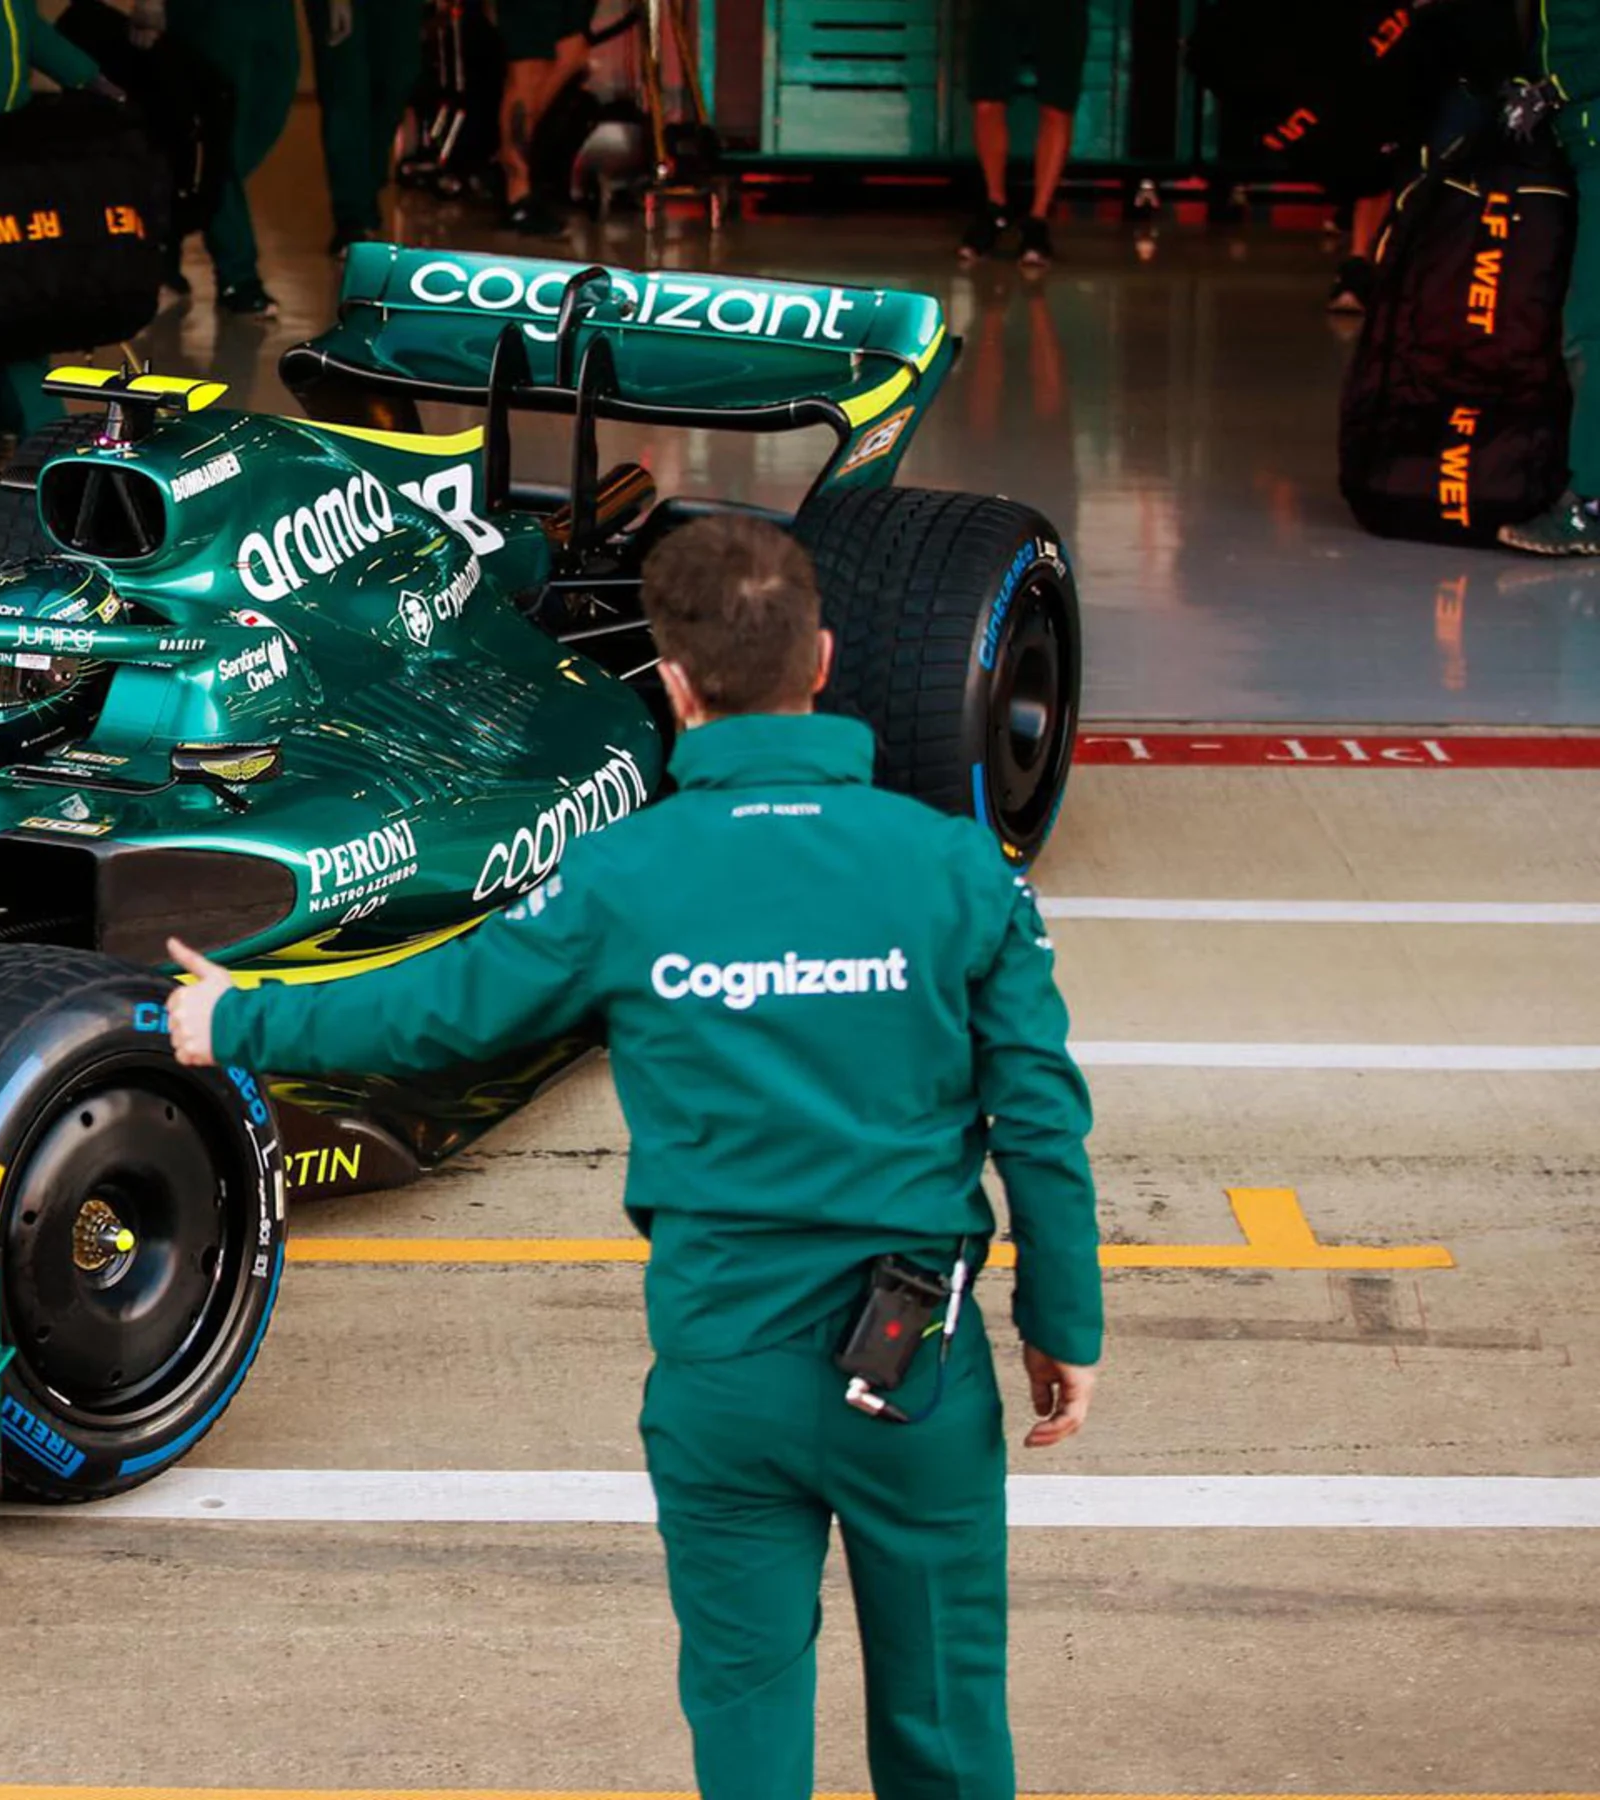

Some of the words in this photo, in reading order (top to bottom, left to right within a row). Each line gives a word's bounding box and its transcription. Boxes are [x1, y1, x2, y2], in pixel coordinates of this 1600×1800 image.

[27, 209, 62, 241] RF
[410, 261, 854, 342] cognizant
[1467, 249, 1502, 334] WET
[169, 450, 242, 503] BOMBARDIER
[1439, 444, 1471, 528] WET
[238, 469, 394, 602] aramco
[159, 638, 206, 651] OAKLEY
[218, 640, 268, 682] Sentinel
[247, 668, 275, 692] One
[1266, 739, 1453, 763] PIT
[472, 743, 648, 901] cognizant
[306, 818, 417, 896] PERONI
[309, 884, 365, 913] NASTRO
[365, 862, 419, 898] AZZURRO
[651, 948, 908, 1010] Cognizant
